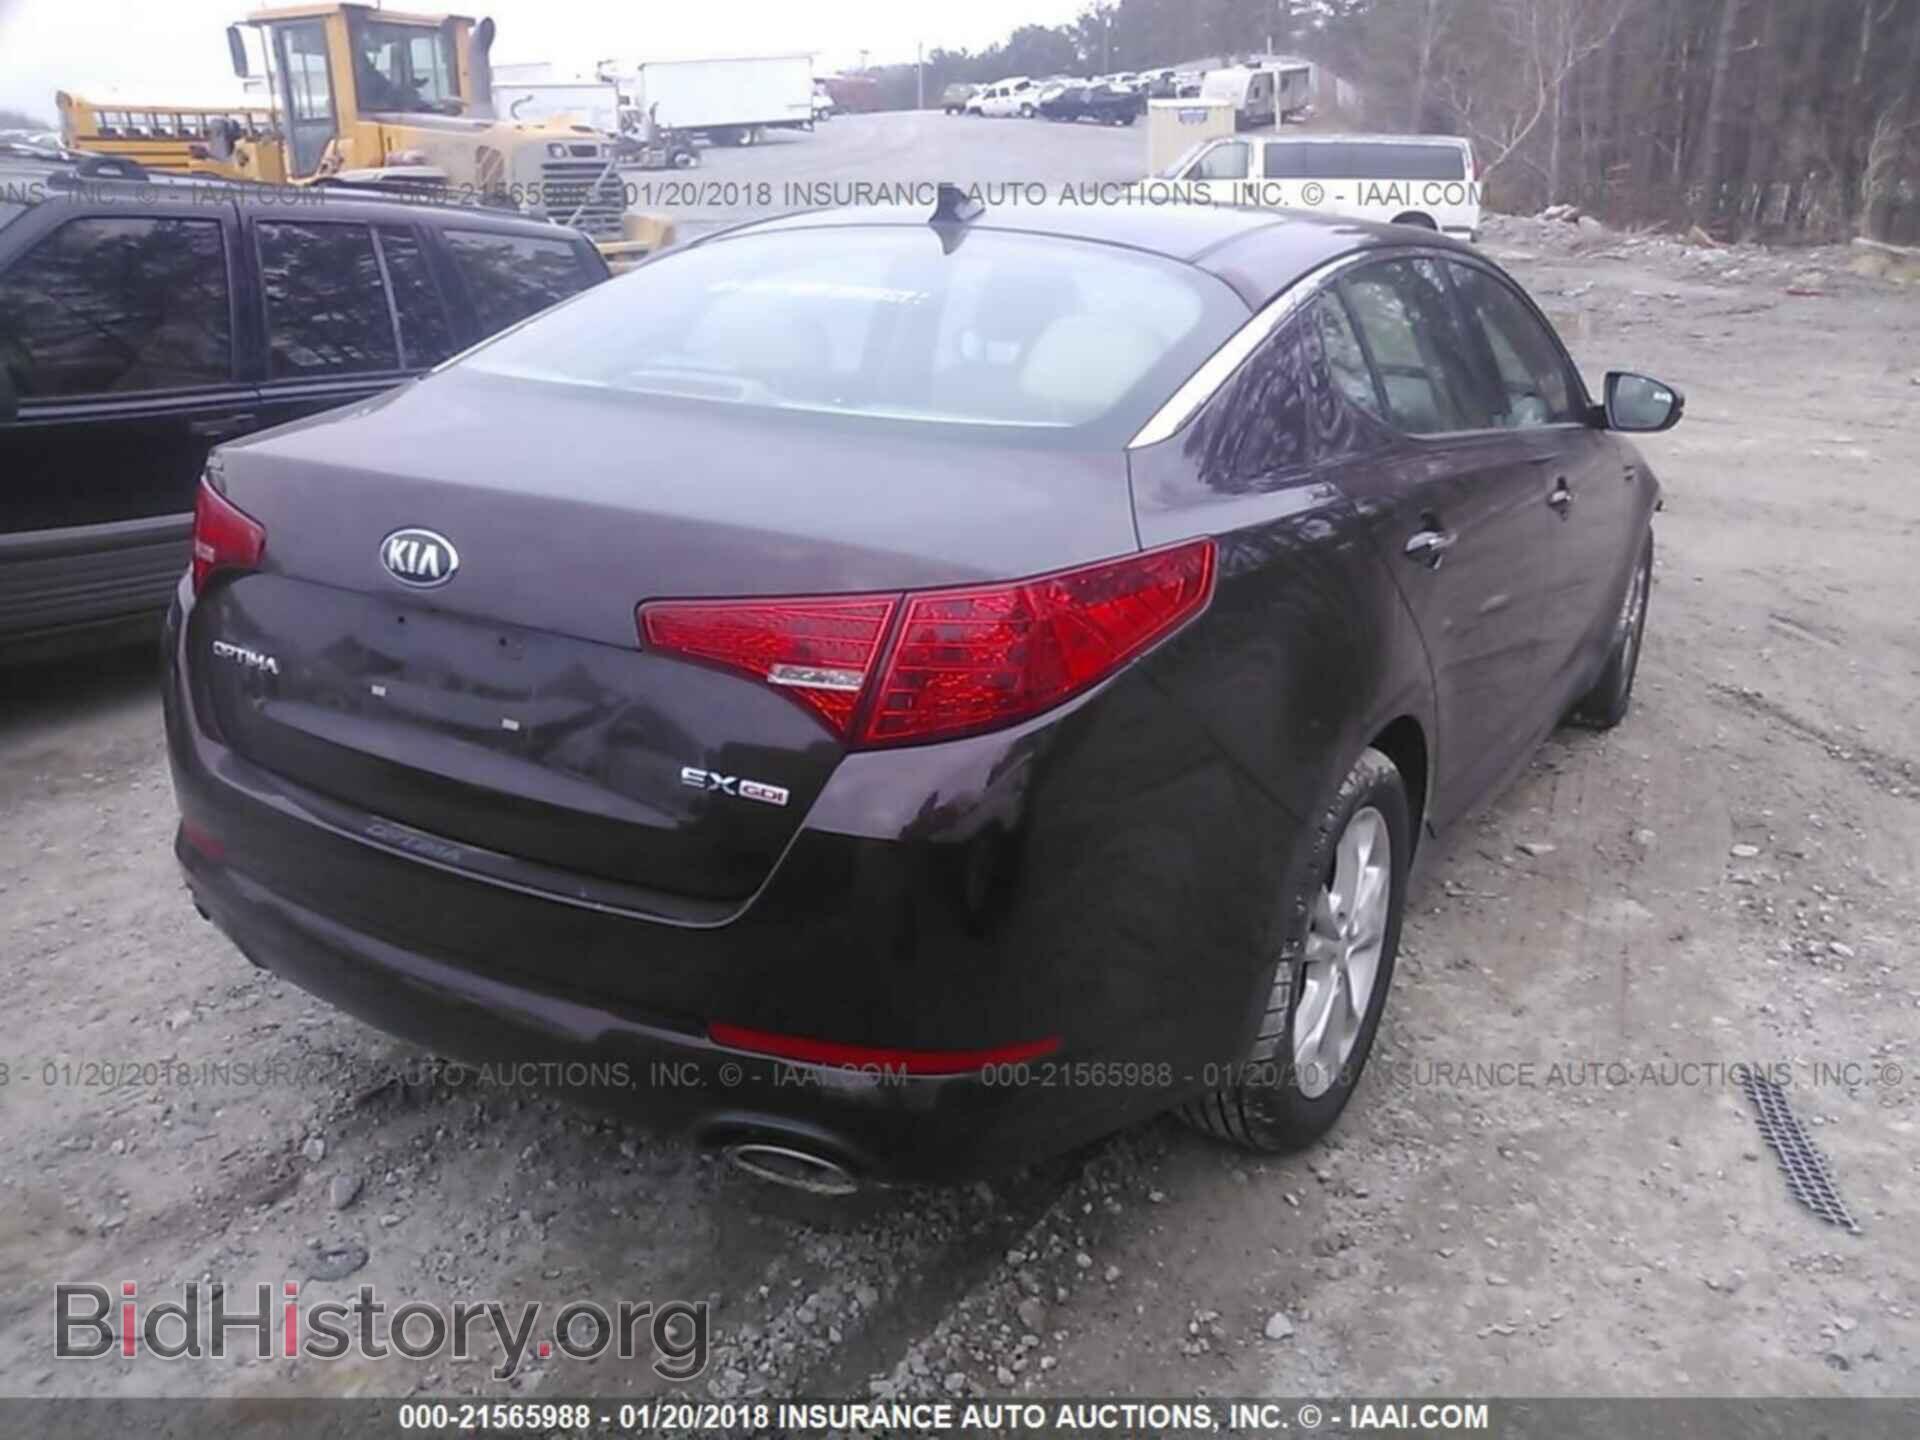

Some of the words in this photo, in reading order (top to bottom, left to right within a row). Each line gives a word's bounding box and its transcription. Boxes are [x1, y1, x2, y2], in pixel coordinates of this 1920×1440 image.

[388, 538, 440, 578] KIA
[212, 639, 280, 675] OPTIMA
[681, 766, 738, 796] EX
[741, 782, 787, 804] GDI
